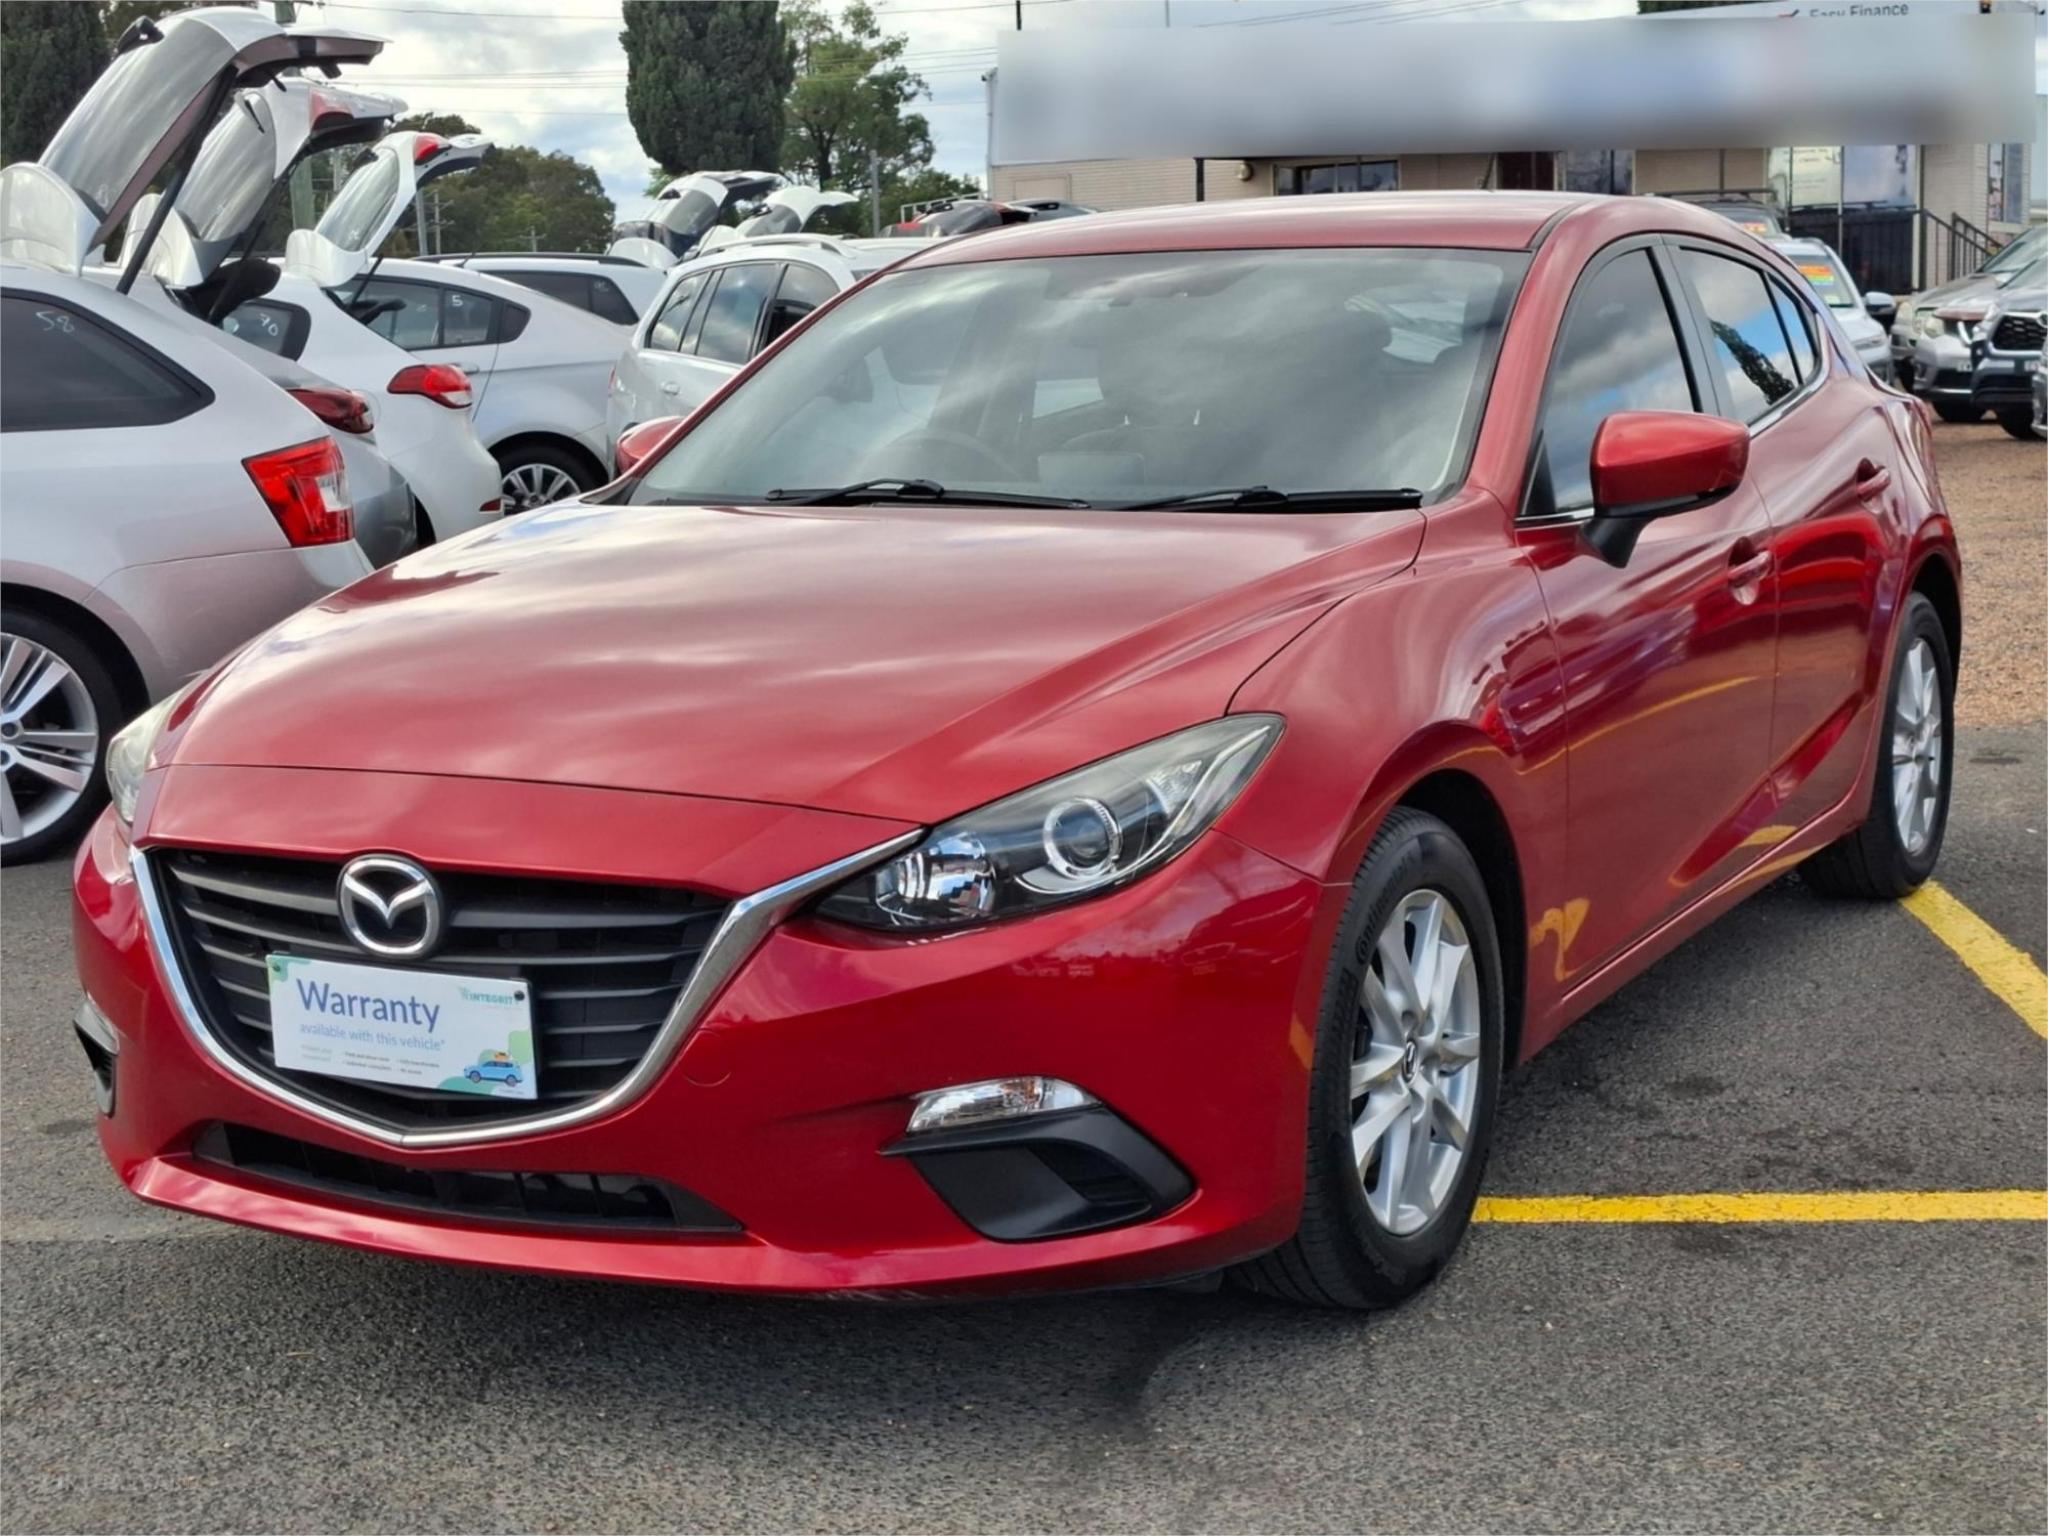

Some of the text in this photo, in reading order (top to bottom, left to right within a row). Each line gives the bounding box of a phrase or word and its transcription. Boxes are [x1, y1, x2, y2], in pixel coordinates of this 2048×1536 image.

[1850, 4, 1909, 16] Finance
[296, 978, 440, 1033] Warranty
[300, 1023, 346, 1040] available
[348, 1029, 374, 1044] with
[376, 1031, 398, 1047] this
